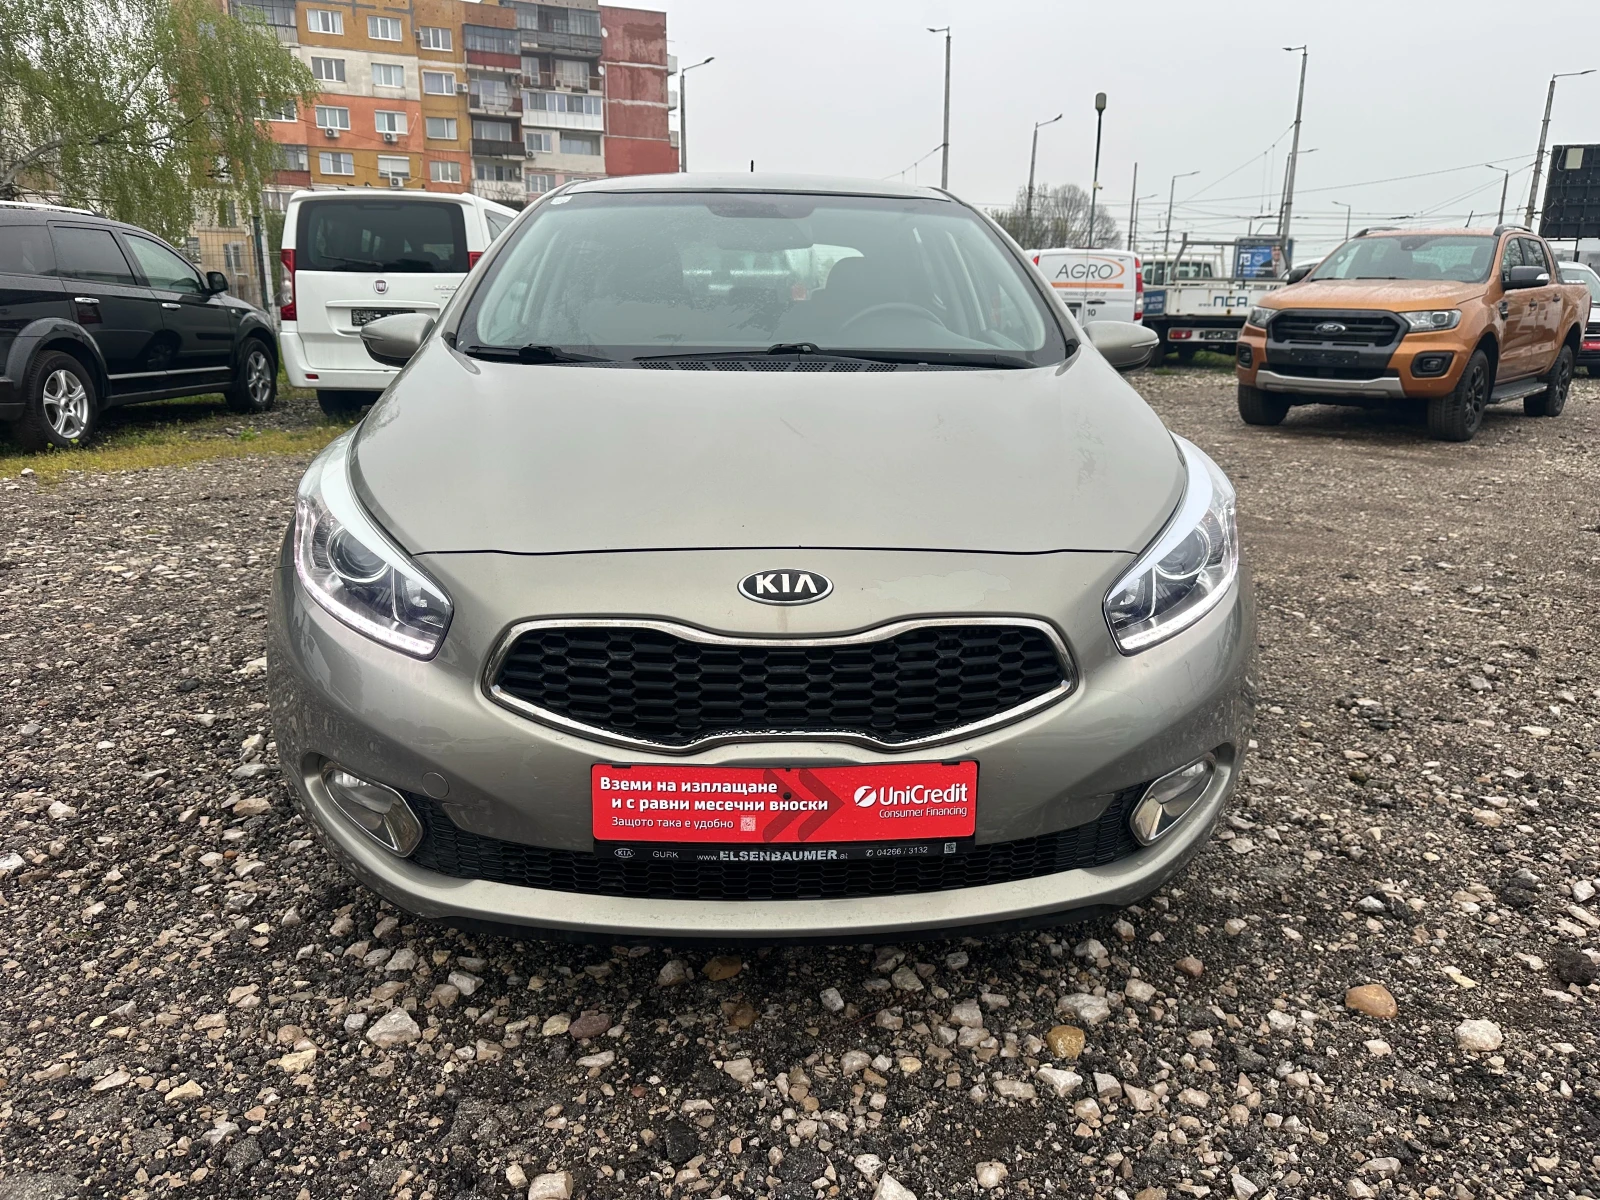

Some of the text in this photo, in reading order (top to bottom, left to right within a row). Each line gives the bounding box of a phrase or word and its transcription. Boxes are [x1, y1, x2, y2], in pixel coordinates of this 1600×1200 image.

[1055, 263, 1114, 280] AGRO
[1087, 308, 1097, 316] 10
[755, 573, 818, 594] KIA
[600, 776, 777, 795] Вземи на изплащане
[880, 782, 968, 806] UniCredit
[611, 798, 828, 812] и с равни месечни вноски
[879, 805, 968, 819] Consumer Financing
[611, 816, 734, 830] Защото така е удобно
[652, 850, 679, 859] GURK
[876, 847, 902, 857] 04266
[908, 846, 928, 854] 3132
